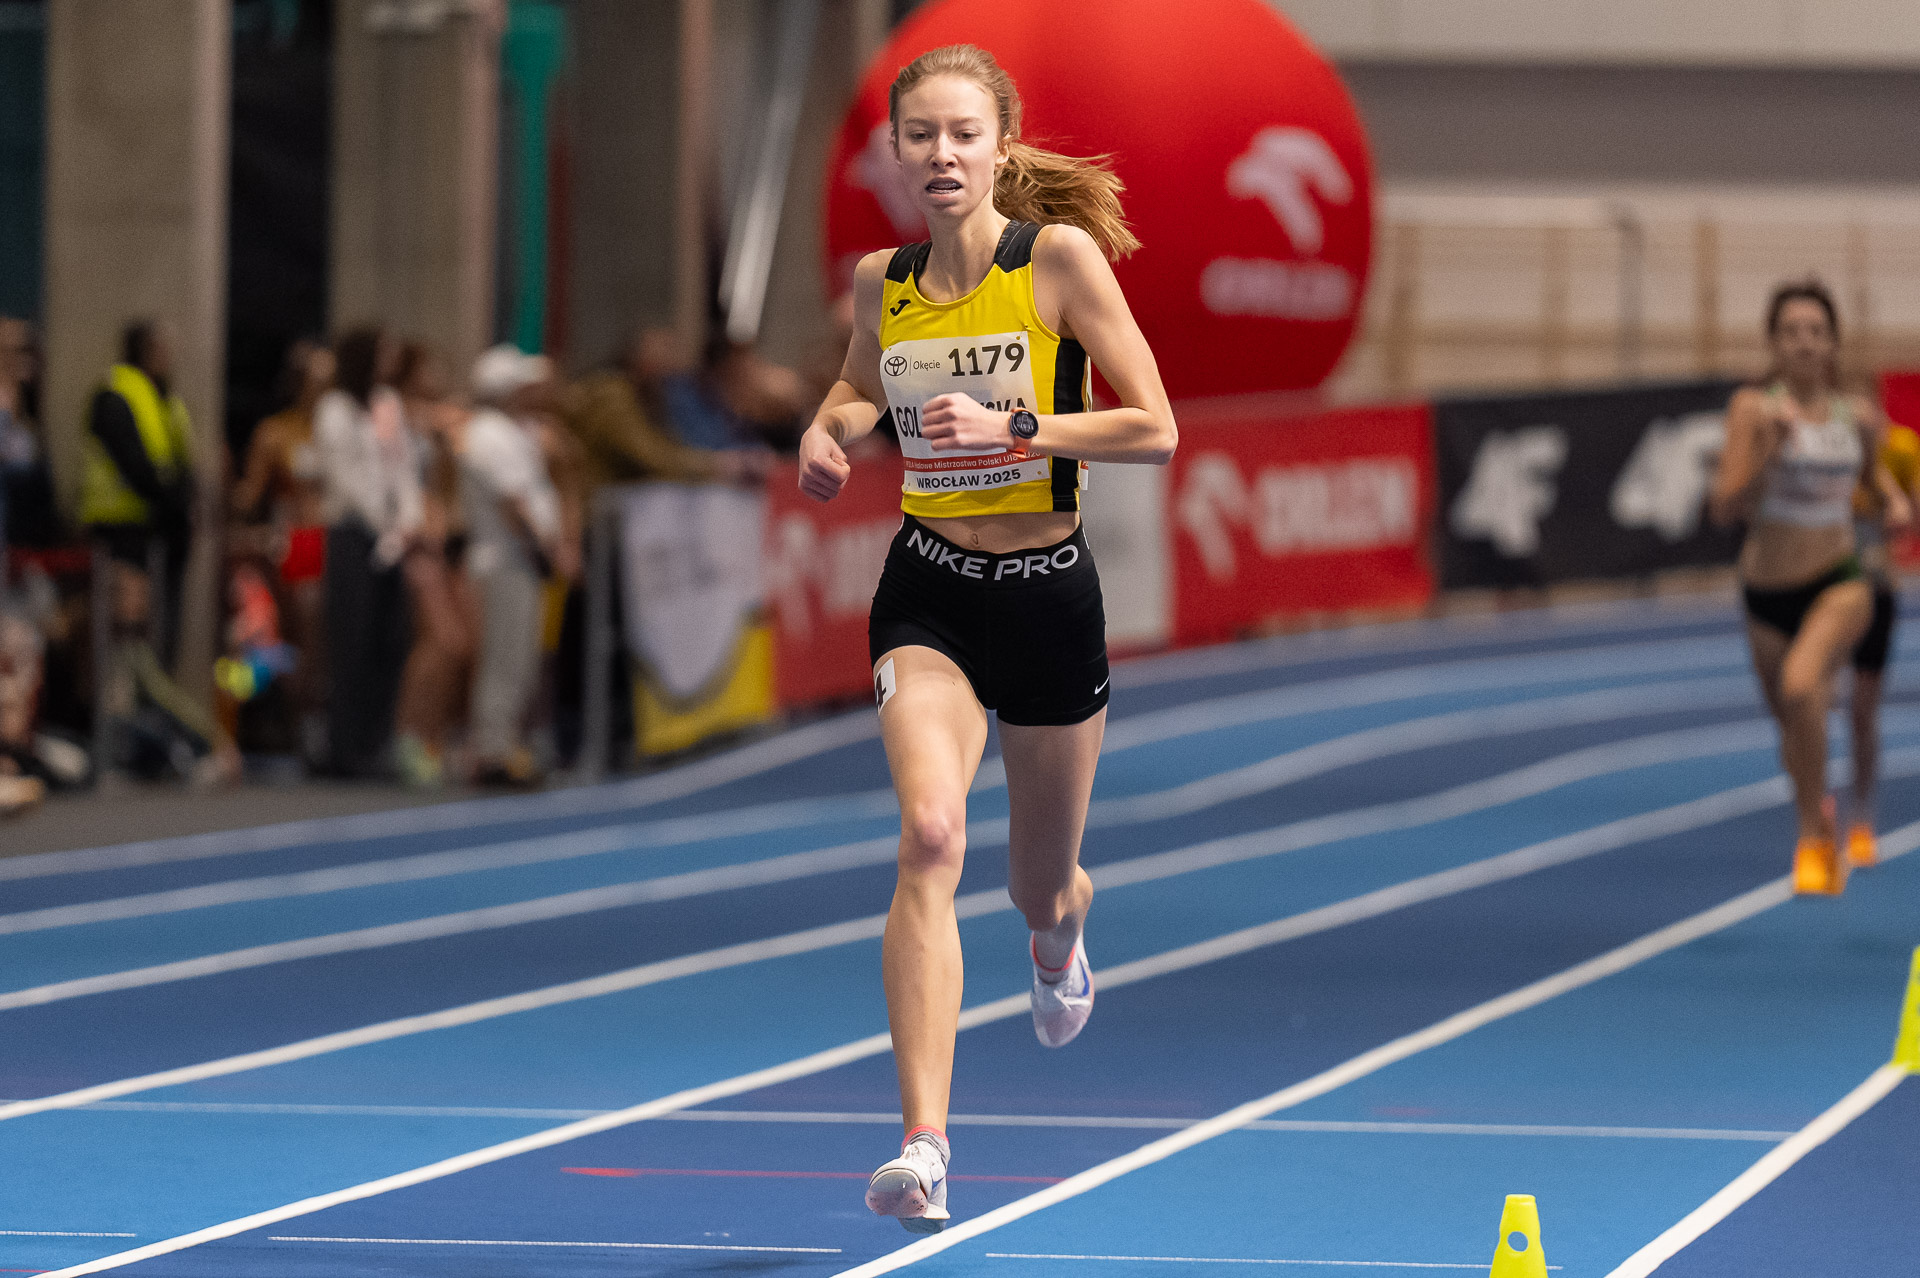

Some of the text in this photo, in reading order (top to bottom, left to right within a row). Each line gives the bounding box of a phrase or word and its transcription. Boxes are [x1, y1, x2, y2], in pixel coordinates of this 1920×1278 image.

[913, 343, 1025, 377] Okęcie 1179
[933, 460, 977, 469] Mistrzostwa
[978, 457, 1002, 466] Polski
[916, 468, 1021, 489] WROCŁAW 2025
[906, 529, 989, 579] NIKE
[994, 544, 1079, 581] PRO
